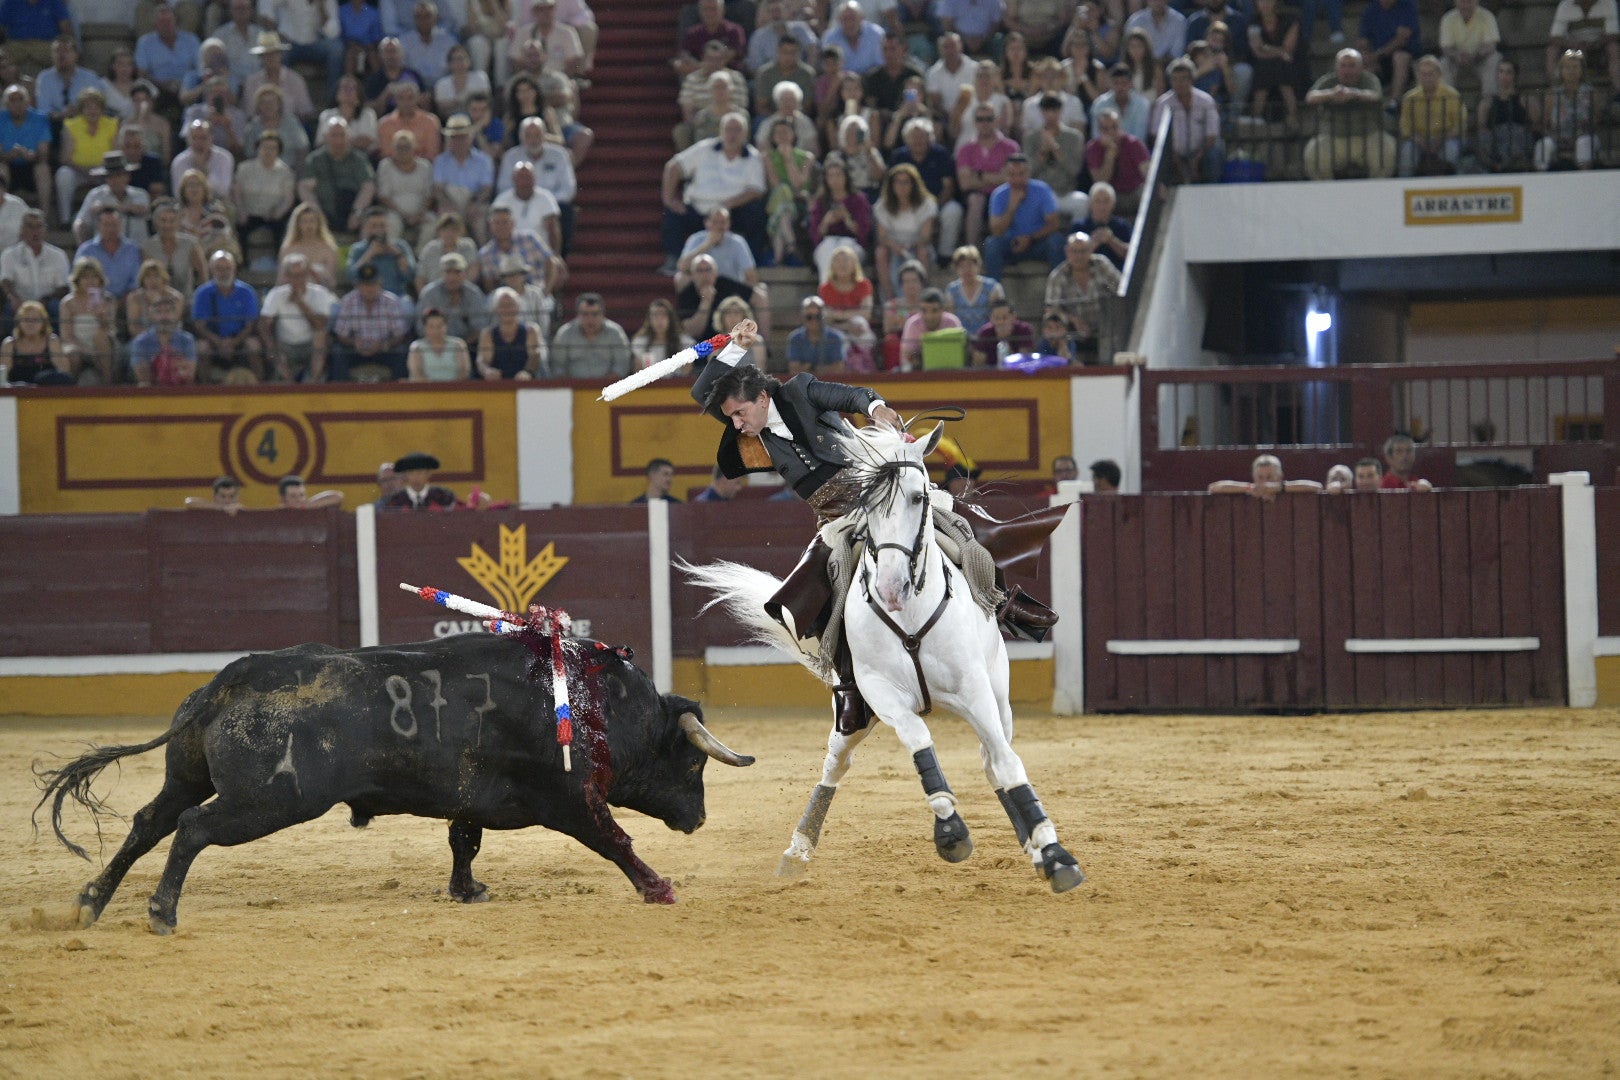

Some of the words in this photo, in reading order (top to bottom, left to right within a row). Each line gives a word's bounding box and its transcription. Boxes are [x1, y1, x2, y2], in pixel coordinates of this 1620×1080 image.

[1413, 196, 1511, 212] ARRASTRE
[256, 428, 278, 464] 4
[385, 669, 497, 747] 877
